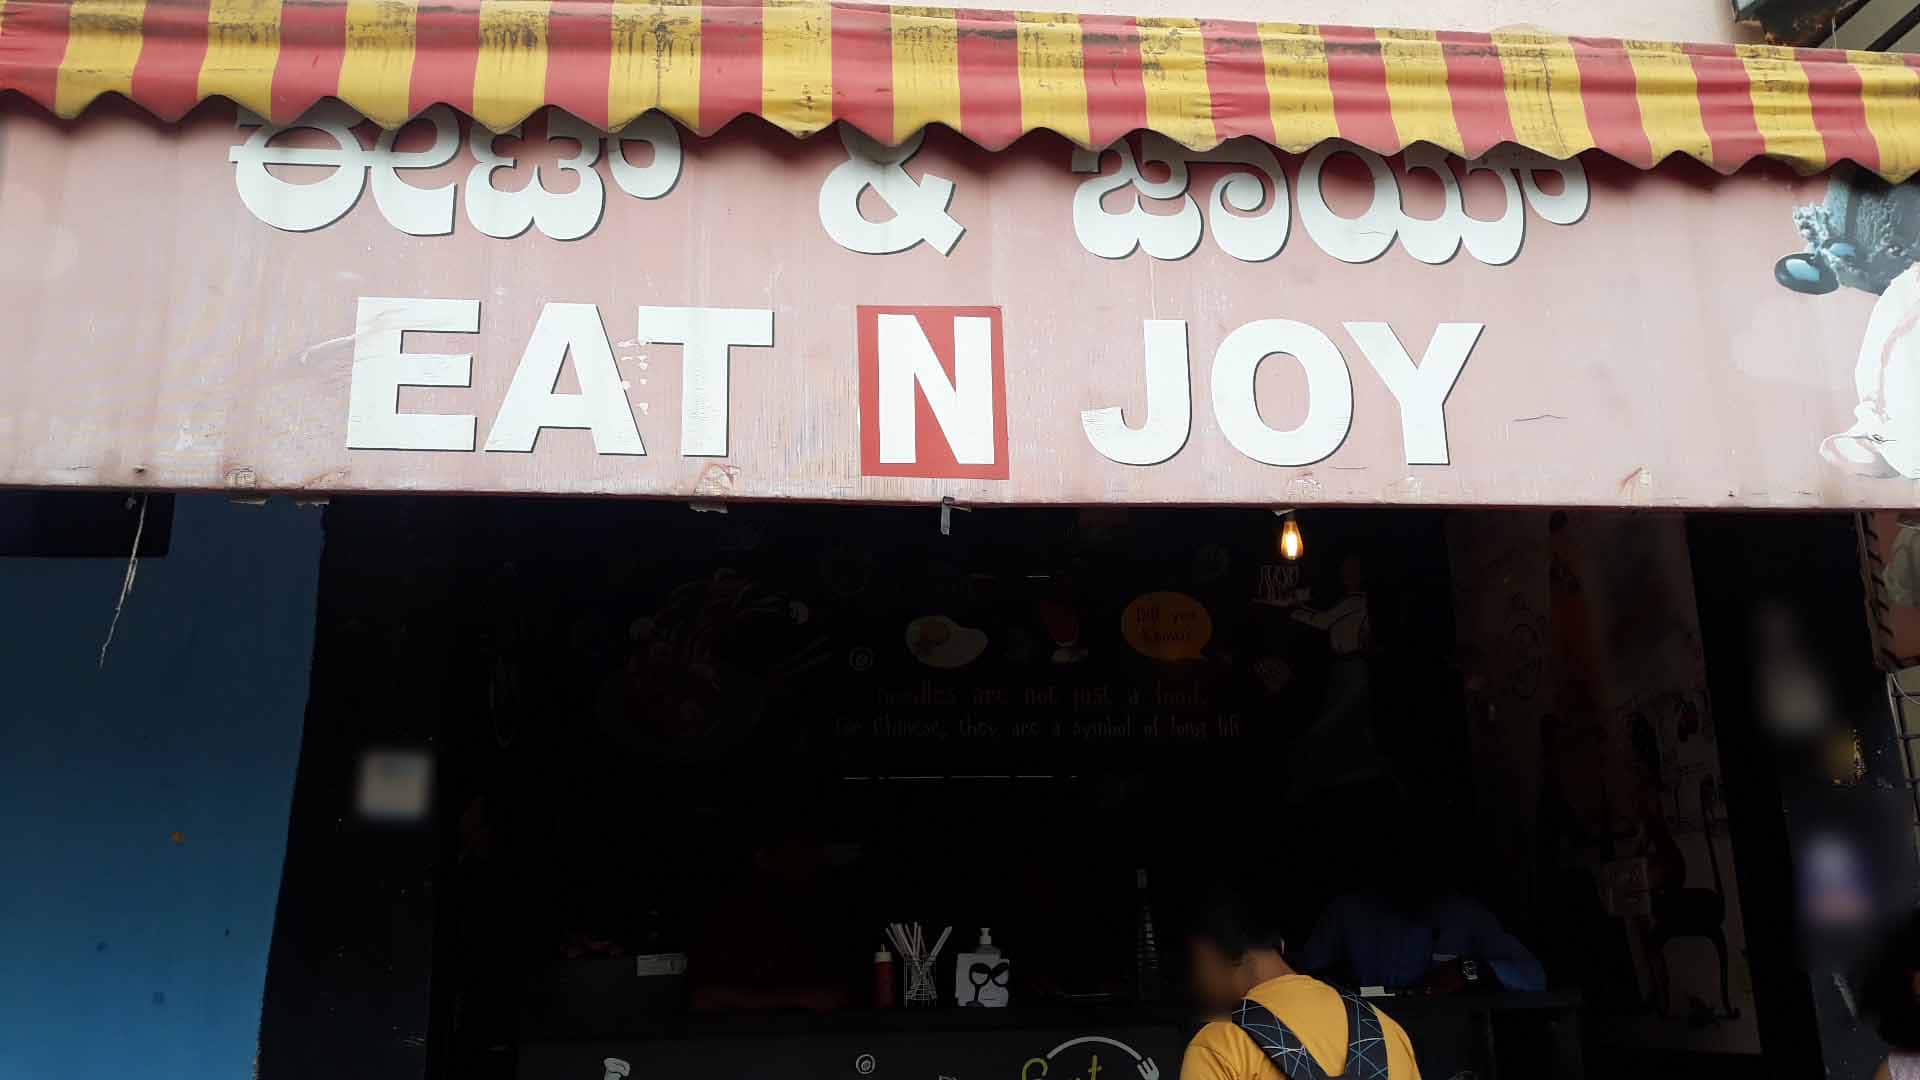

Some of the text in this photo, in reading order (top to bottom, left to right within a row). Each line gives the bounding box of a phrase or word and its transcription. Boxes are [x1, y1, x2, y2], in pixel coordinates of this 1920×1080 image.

[818, 124, 966, 257] &
[346, 297, 1486, 467] EAT N JOY
[1217, 711, 1248, 737] lif
